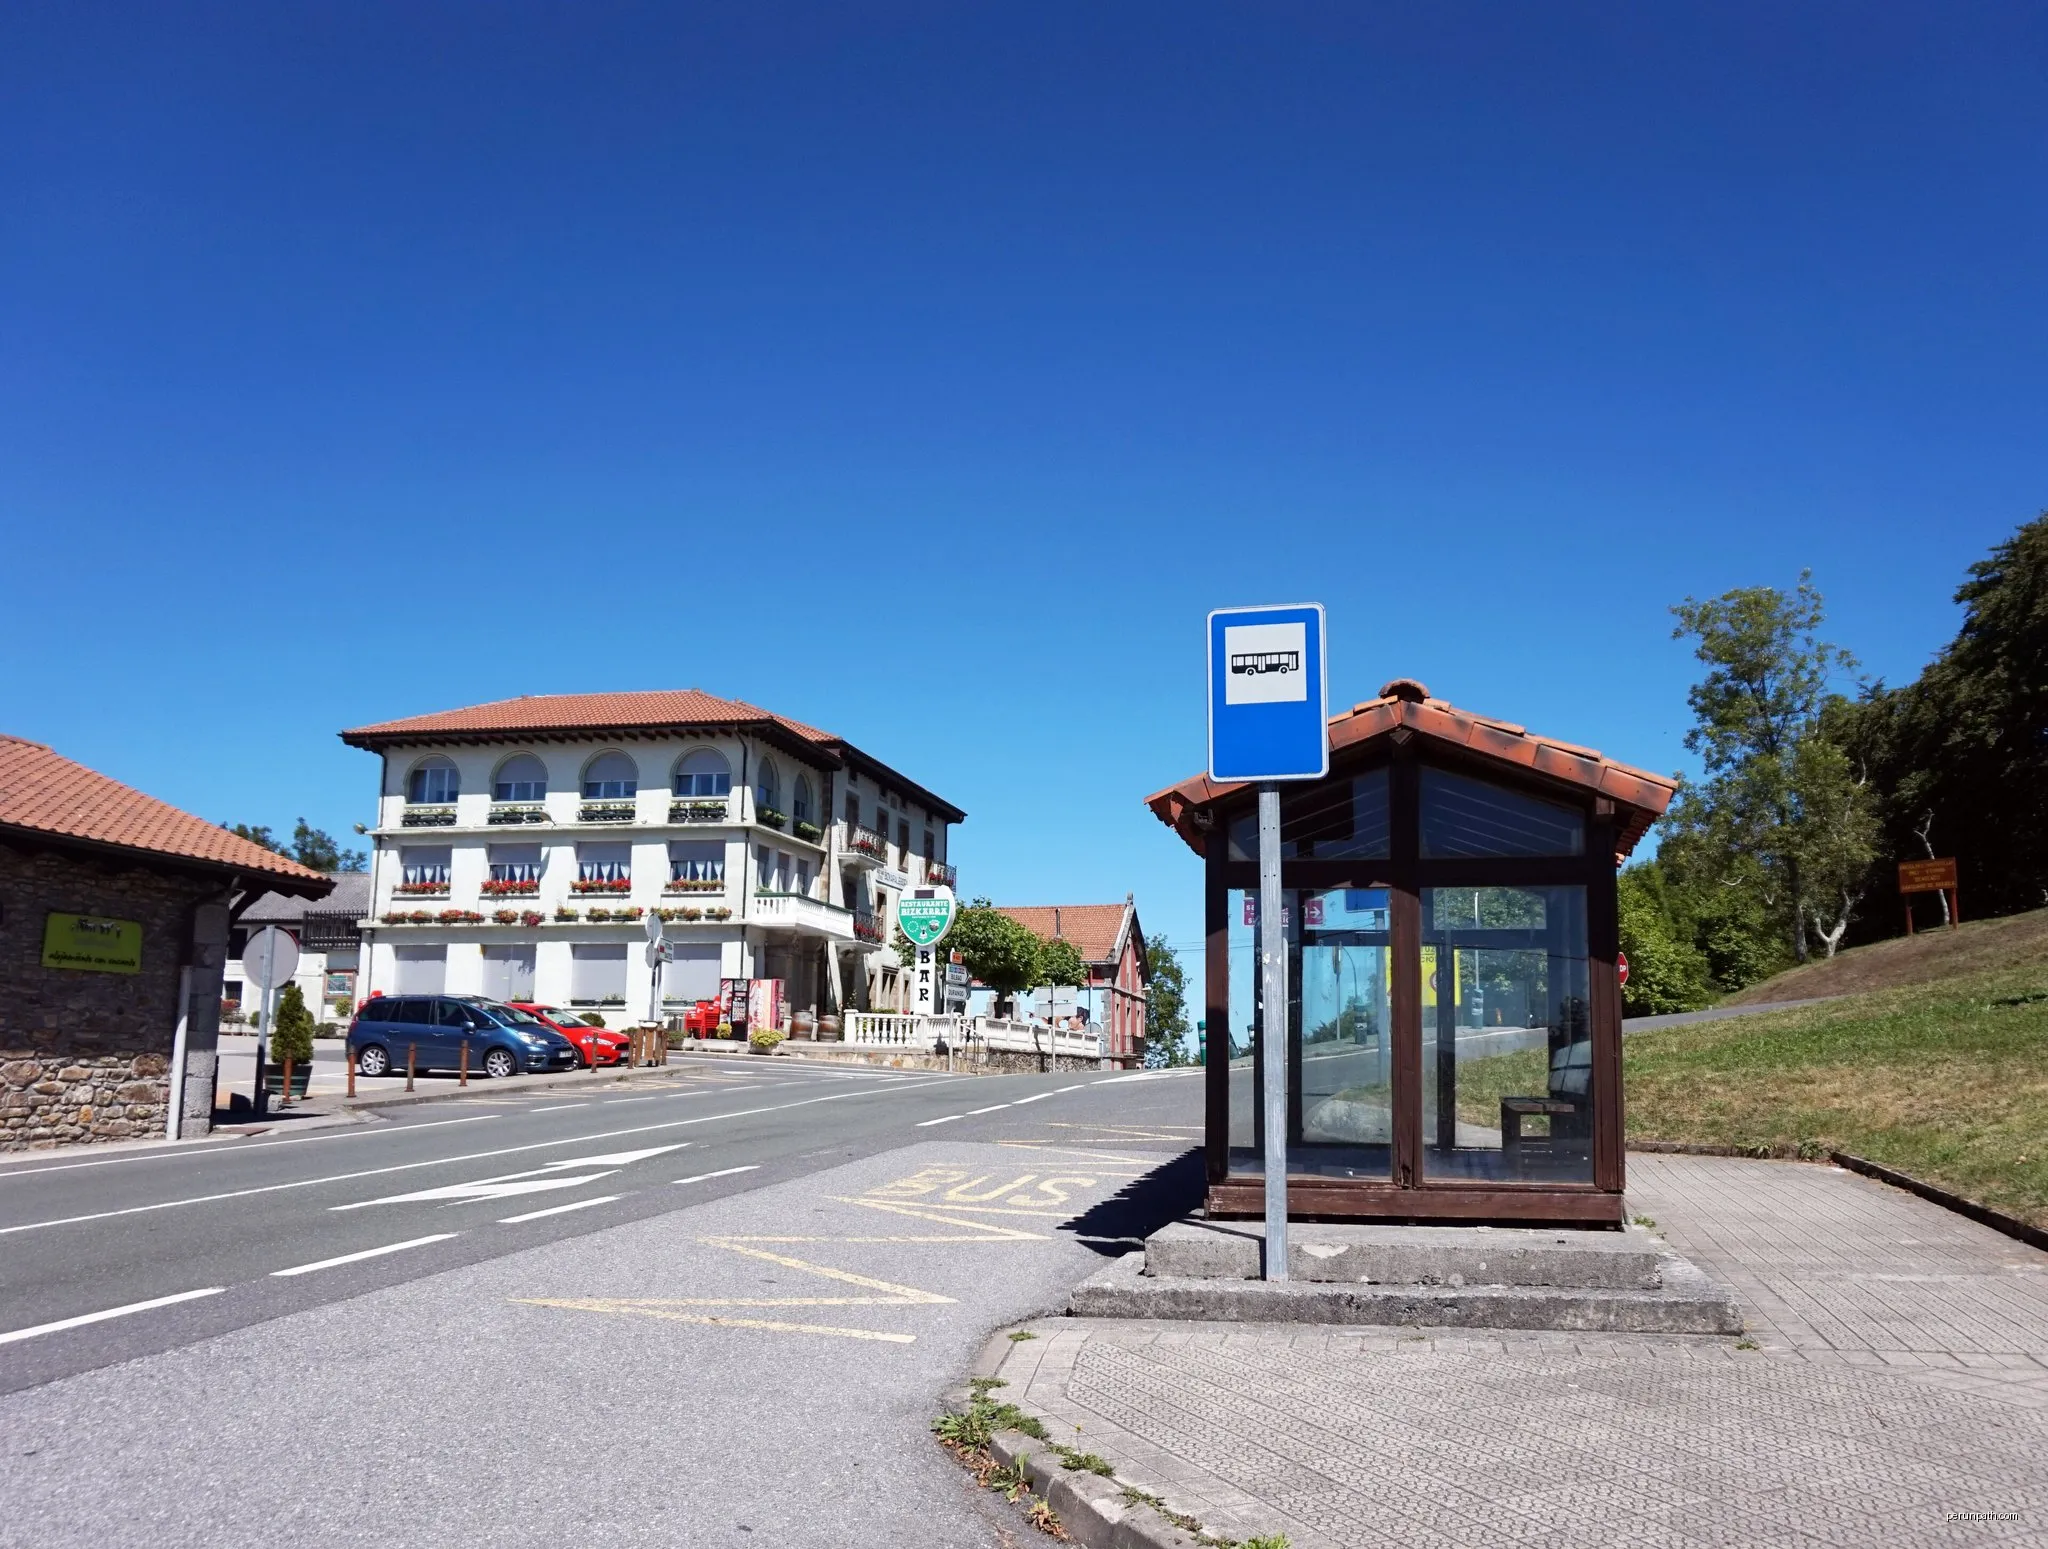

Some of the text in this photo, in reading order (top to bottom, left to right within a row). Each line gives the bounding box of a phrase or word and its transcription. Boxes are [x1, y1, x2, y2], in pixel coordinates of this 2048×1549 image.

[901, 908, 949, 916] BIZKARRA
[919, 950, 931, 1002] BAR
[862, 1168, 1097, 1207] BUS
